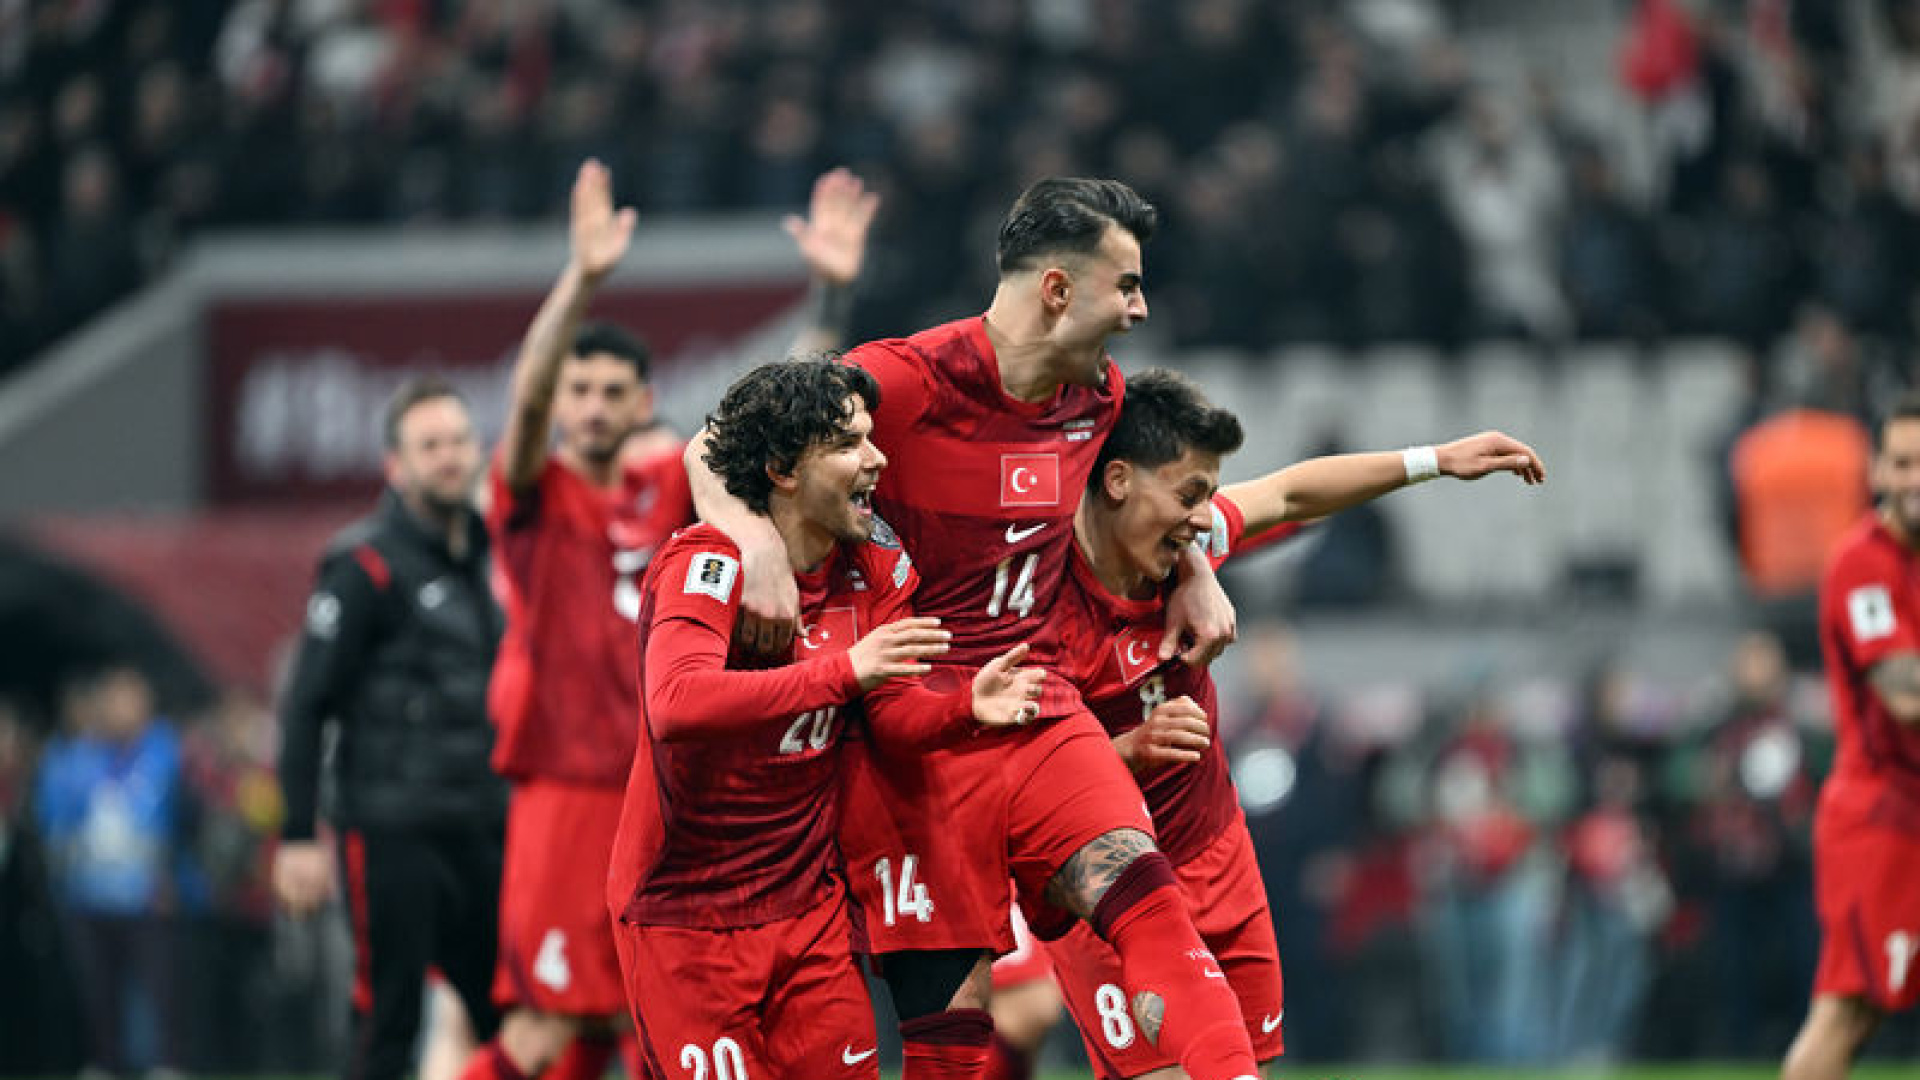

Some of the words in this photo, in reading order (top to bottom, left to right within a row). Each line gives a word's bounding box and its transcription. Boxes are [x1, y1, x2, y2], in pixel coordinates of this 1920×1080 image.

[986, 554, 1038, 617] 14
[874, 854, 934, 926] 14
[533, 926, 571, 993] 4
[1094, 983, 1135, 1049] 8
[680, 1037, 748, 1080] 20
